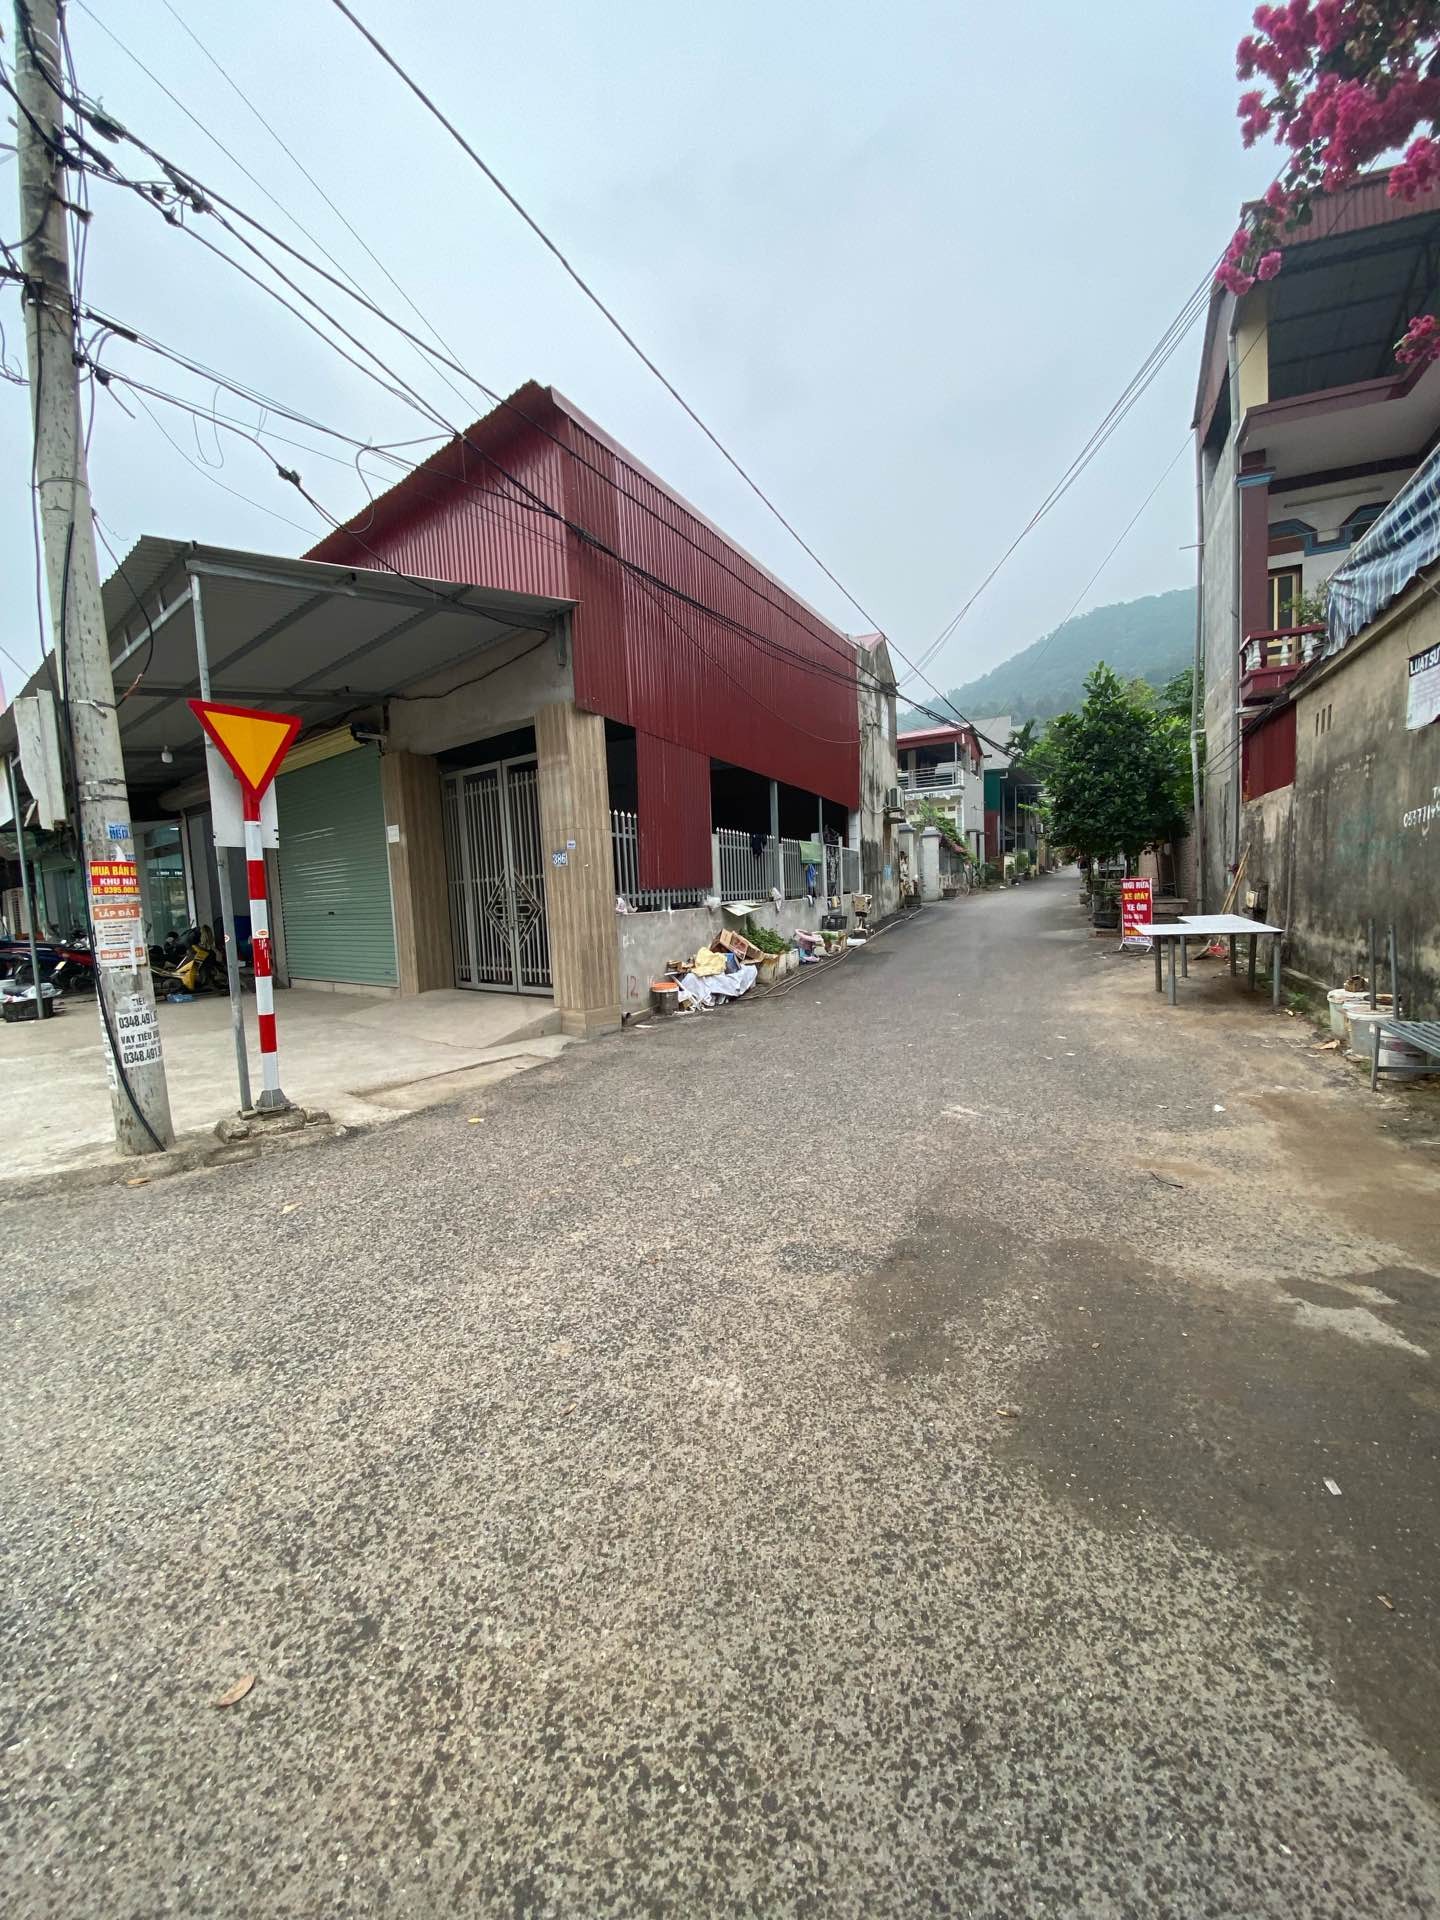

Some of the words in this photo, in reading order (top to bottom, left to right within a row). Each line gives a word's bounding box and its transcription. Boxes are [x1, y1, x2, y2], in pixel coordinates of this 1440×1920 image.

[91, 865, 110, 876] MUA
[111, 863, 129, 876] BÁN
[99, 877, 120, 886] KHU
[121, 1035, 135, 1044] VAY
